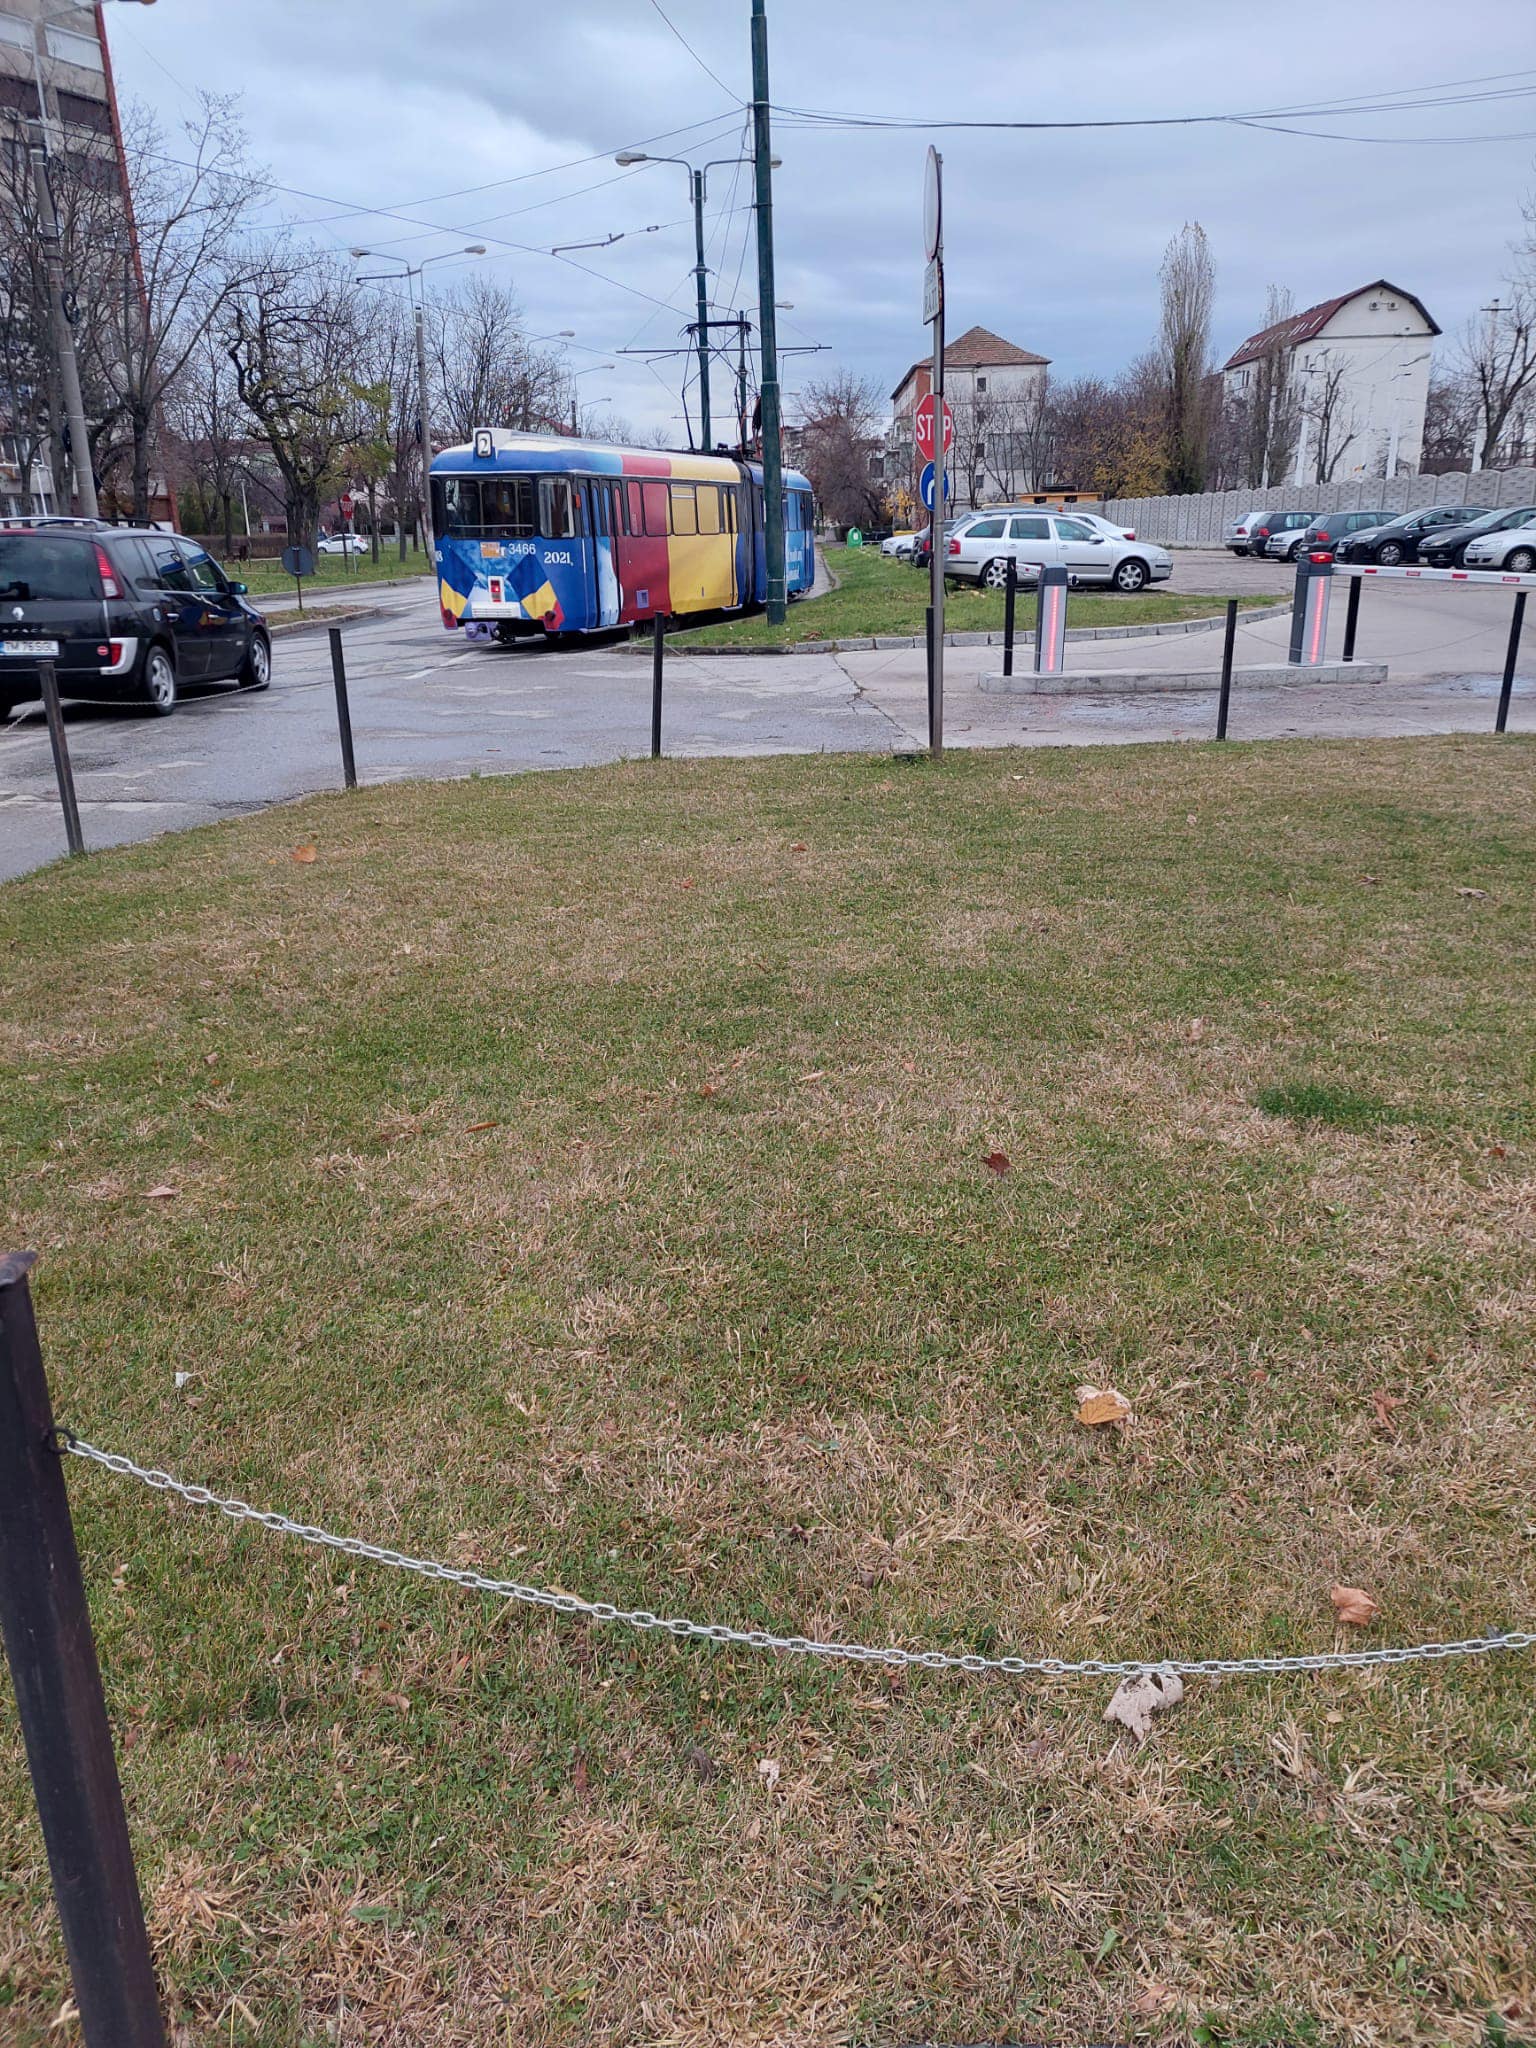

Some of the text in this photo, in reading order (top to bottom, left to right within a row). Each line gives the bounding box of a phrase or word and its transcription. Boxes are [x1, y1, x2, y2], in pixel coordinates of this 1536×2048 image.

[917, 414, 951, 441] STP
[480, 438, 488, 454] 2
[509, 543, 536, 555] 3466
